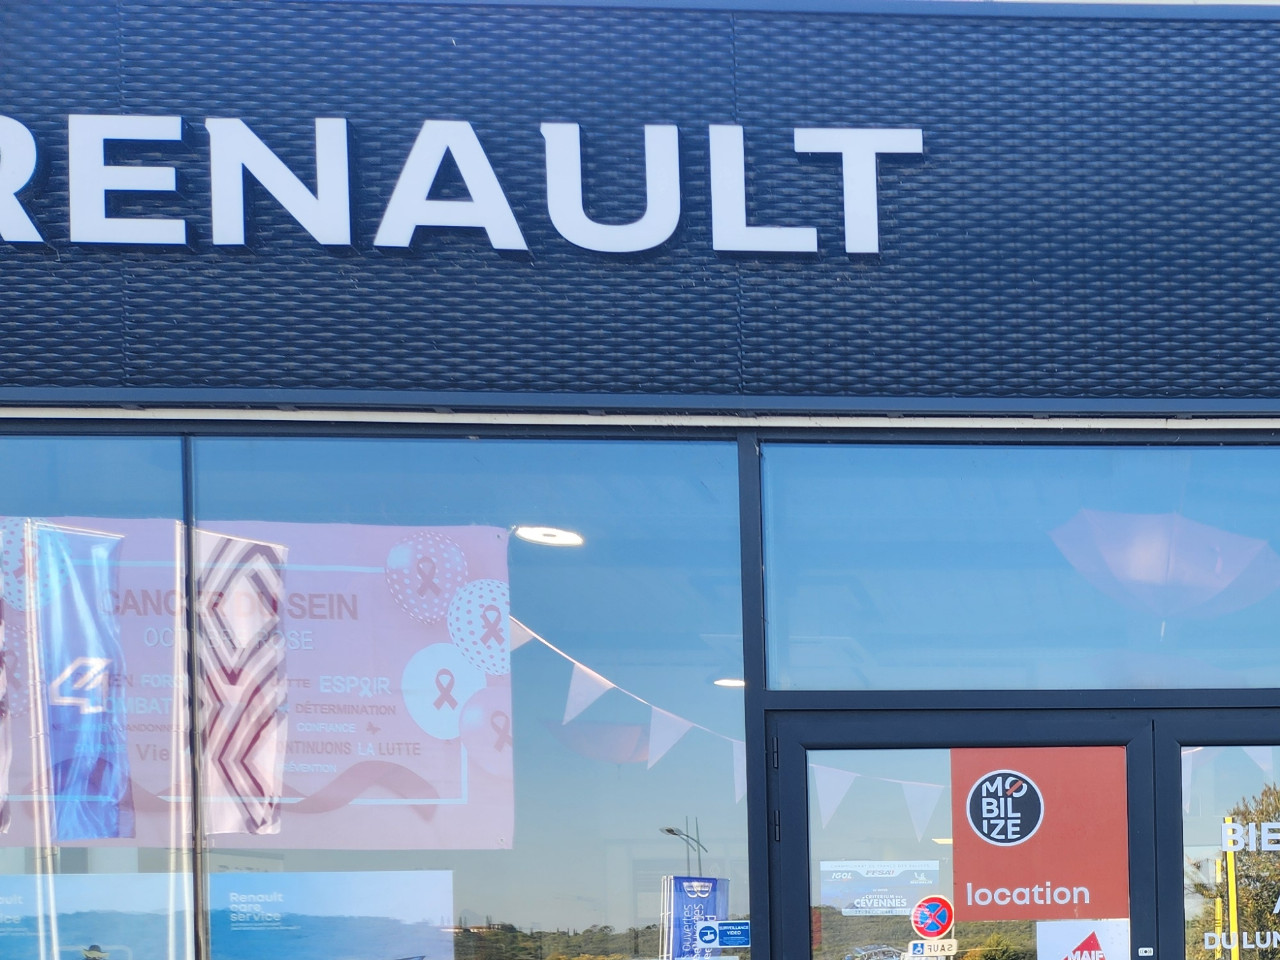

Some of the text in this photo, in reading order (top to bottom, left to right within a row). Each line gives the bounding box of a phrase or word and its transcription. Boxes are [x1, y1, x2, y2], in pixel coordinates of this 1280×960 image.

[286, 592, 359, 621] SEIN
[255, 629, 314, 651] ROSE
[295, 701, 397, 716] DÉTERMINATION
[296, 722, 357, 733] CONFIANCE
[135, 743, 171, 762] Vie
[358, 742, 376, 757] LA
[378, 742, 422, 757] LUTTE
[229, 891, 284, 903] Renault
[966, 881, 1091, 906] location
[229, 903, 262, 912] care
[853, 896, 908, 908] CÉVENNES
[229, 910, 282, 922] service
[1203, 930, 1239, 950] DU
